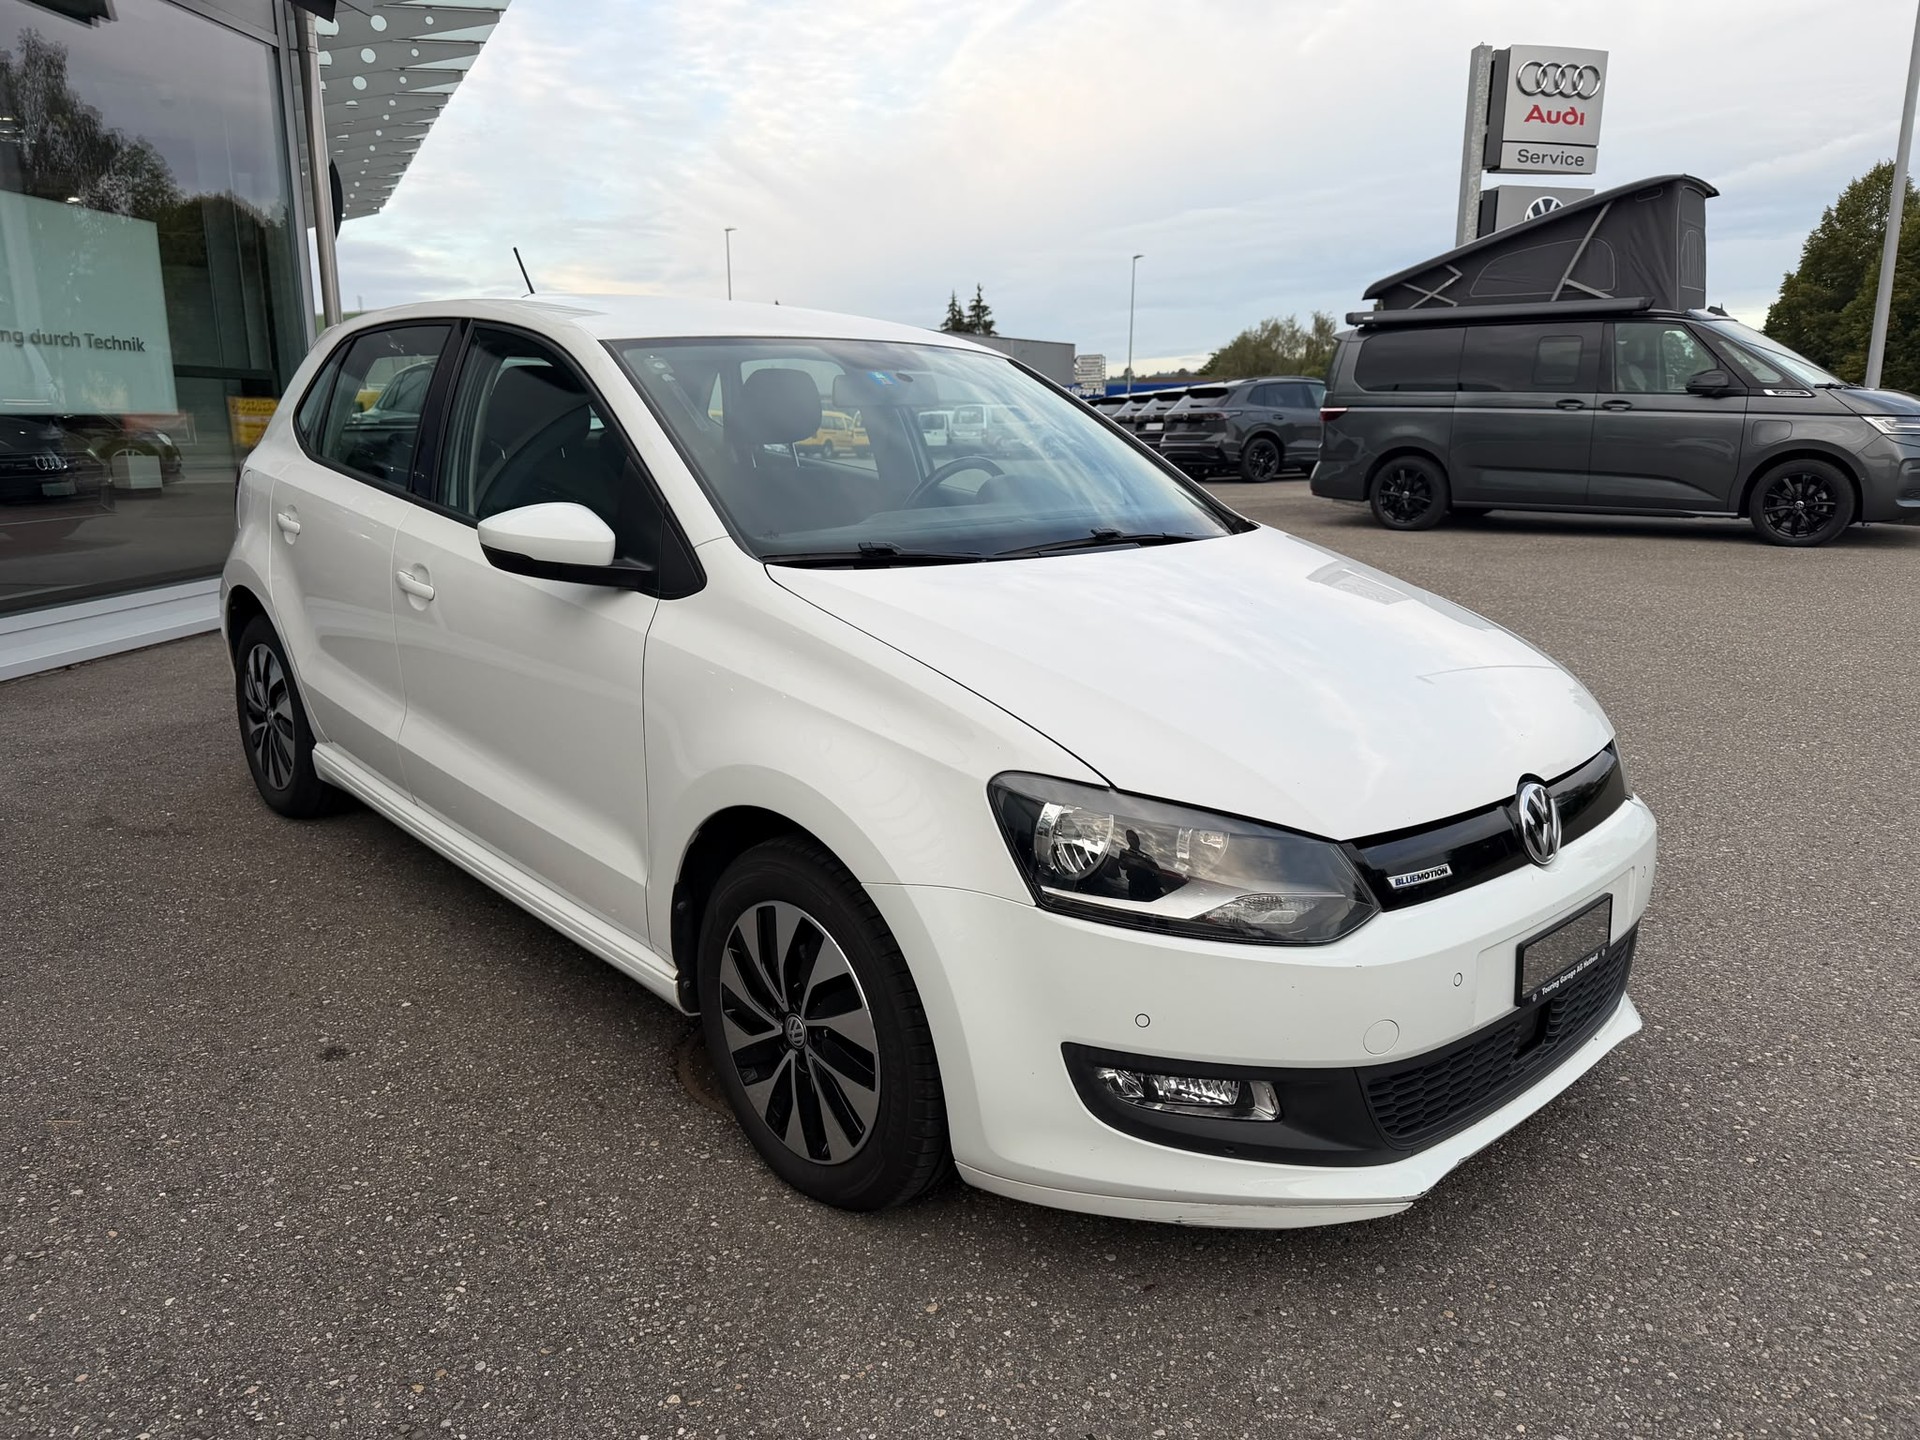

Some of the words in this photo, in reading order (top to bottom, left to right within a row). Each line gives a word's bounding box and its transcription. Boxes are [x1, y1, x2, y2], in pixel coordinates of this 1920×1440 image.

[1524, 104, 1585, 126] Audi
[1517, 149, 1585, 166] Service
[30, 328, 80, 348] durch
[84, 332, 146, 352] Technik
[1395, 866, 1448, 886] BLUEMOTION
[1542, 980, 1559, 995] Touring
[1560, 969, 1576, 984] Garage
